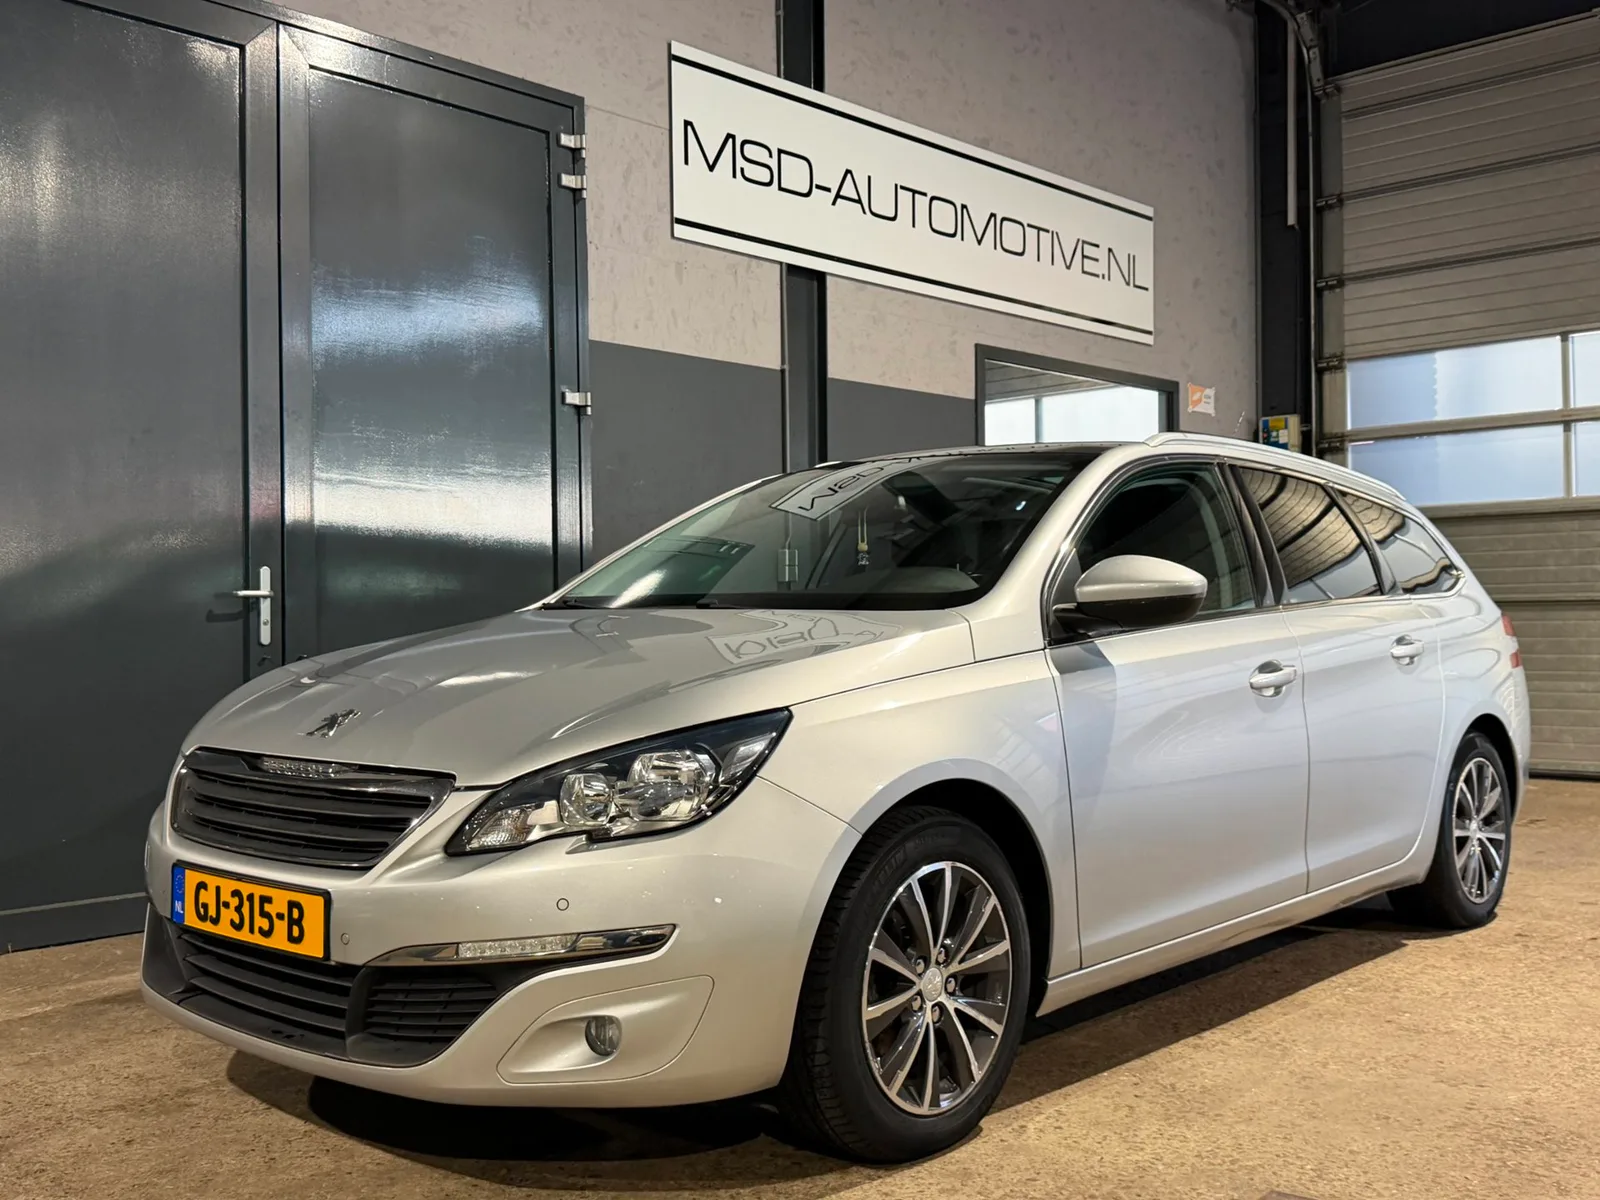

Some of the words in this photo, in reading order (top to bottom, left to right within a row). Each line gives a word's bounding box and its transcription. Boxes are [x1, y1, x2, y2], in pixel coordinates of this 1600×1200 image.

[683, 119, 1149, 291] MSD-AUTOMOTIVE.NL
[175, 900, 184, 914] NL
[194, 881, 305, 944] GJ-315-B
